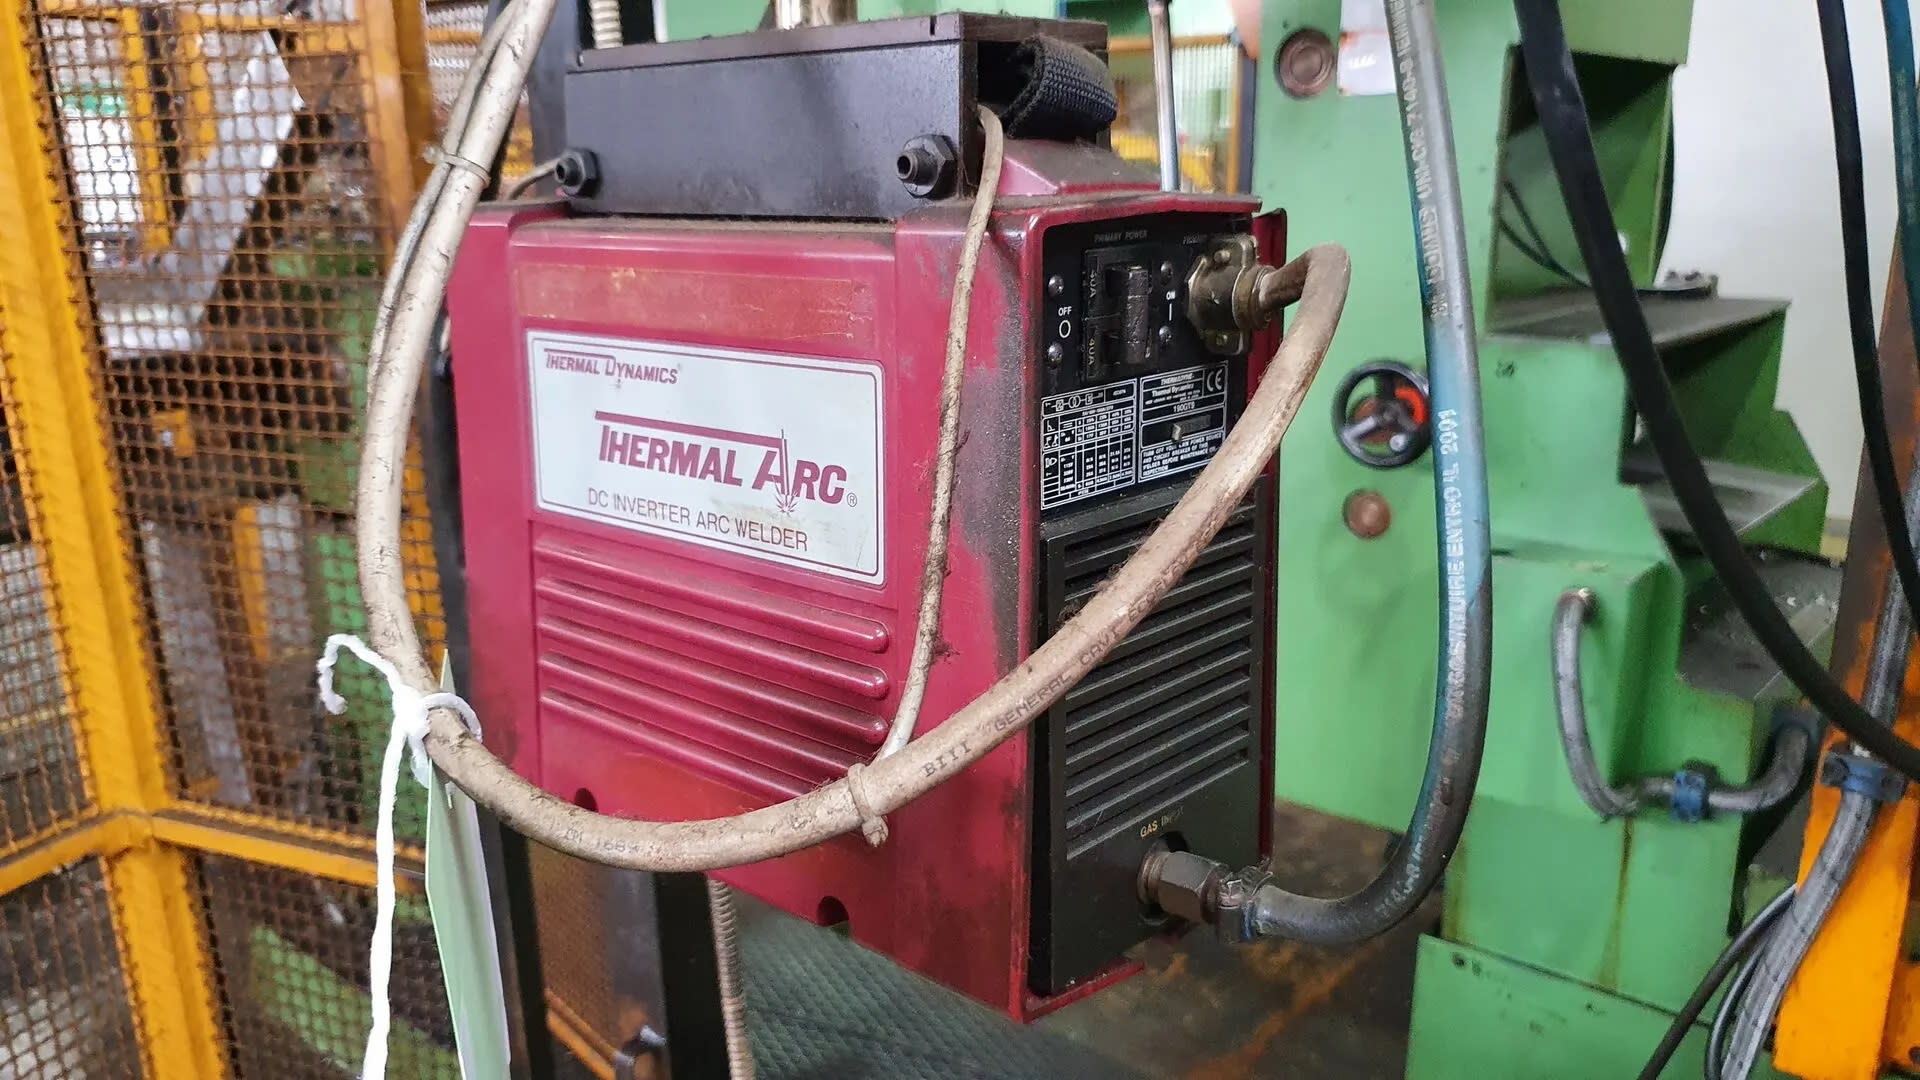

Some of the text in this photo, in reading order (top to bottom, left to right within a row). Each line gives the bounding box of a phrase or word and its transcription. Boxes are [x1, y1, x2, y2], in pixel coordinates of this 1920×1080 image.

[1058, 306, 1073, 317] OFF
[1165, 290, 1176, 300] ON
[544, 349, 680, 385] THERMAL DYNAMICS
[1438, 409, 1459, 455] 2001
[595, 411, 848, 506] THERMAL ARC
[588, 487, 809, 552] DC INVERTER ARC WELDER
[1443, 486, 1464, 557] ENTRO
[993, 672, 1074, 732] GENERAL
[1140, 820, 1158, 838] GAS
